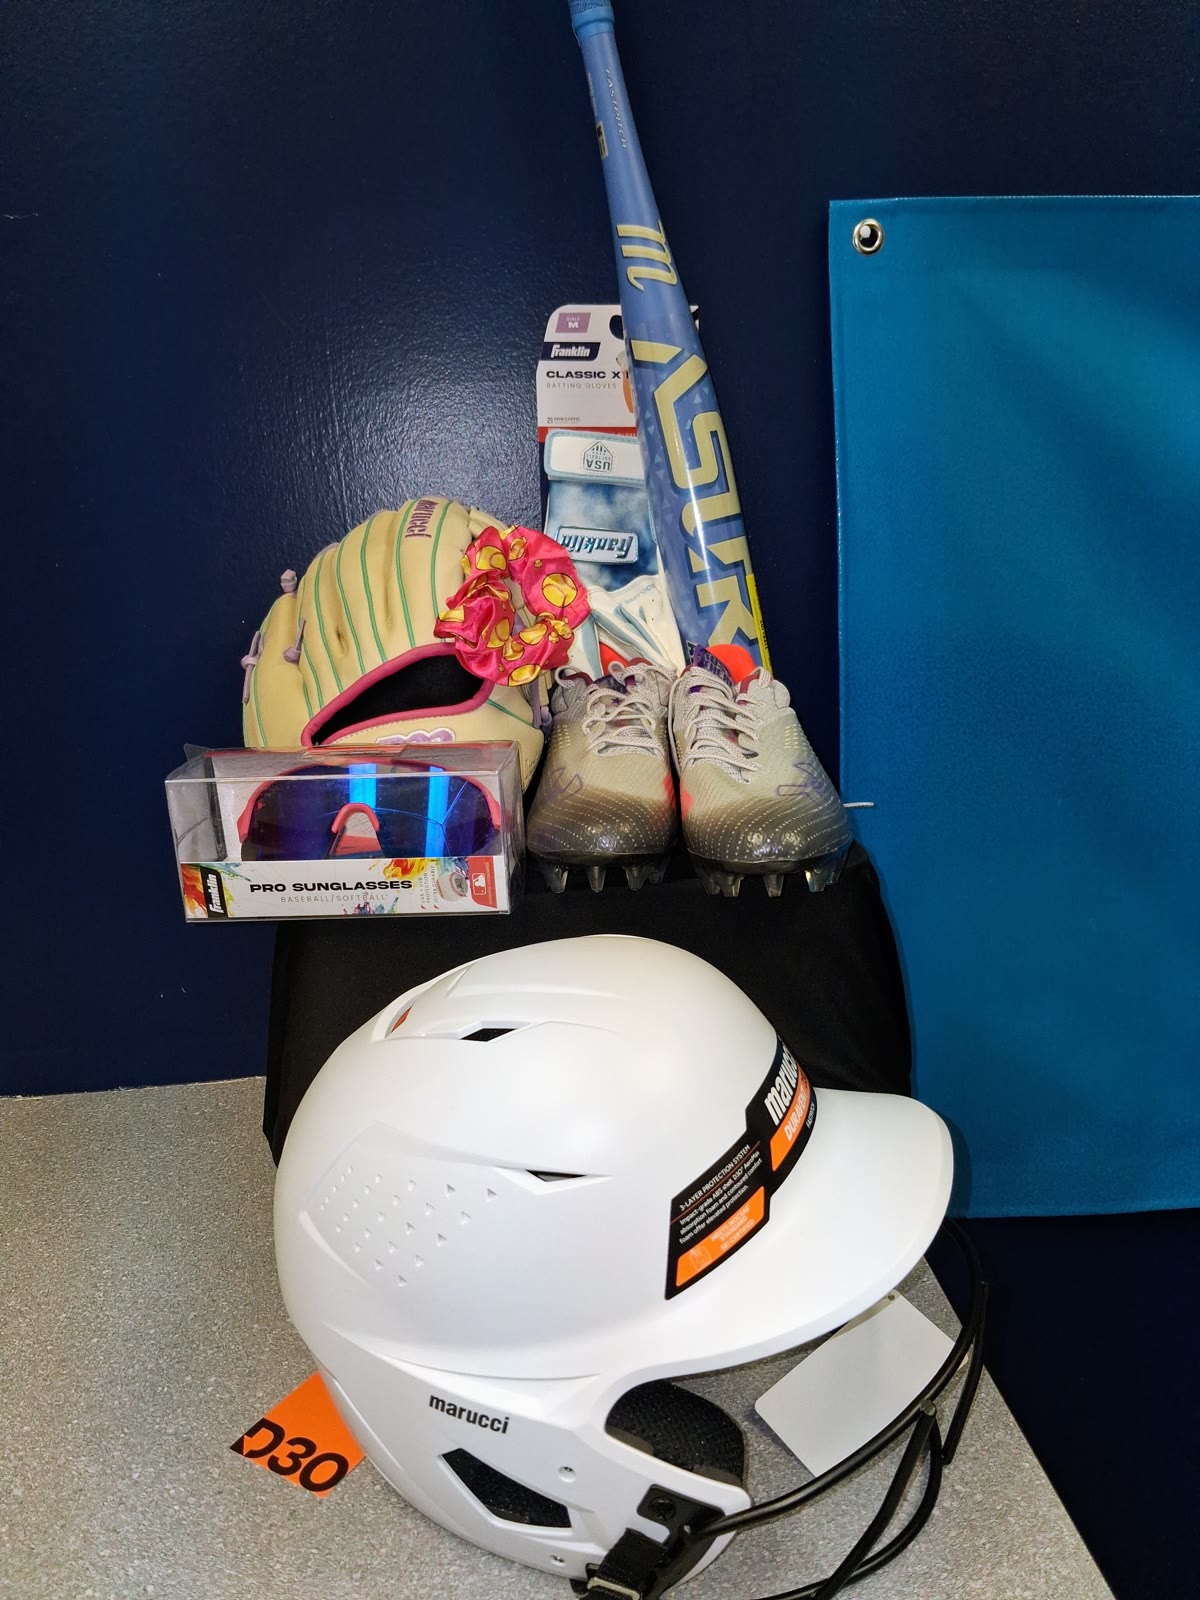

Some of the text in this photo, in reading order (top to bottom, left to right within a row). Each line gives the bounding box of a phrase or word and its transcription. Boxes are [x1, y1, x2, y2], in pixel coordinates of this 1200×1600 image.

[605, 69, 627, 149] FASTPITCH
[546, 370, 606, 379] CLASSIC
[612, 371, 621, 379] X
[586, 458, 610, 471] USA
[250, 880, 413, 893] PRO SUNGLASSES
[679, 1144, 751, 1212] 3-LAYER PROTECTION SYSTEM
[680, 1157, 763, 1236] absorption foam and contoured comfort
[679, 1197, 713, 1226] Impact-grade
[712, 1188, 723, 1200] ABS
[679, 1232, 694, 1244] foam
[693, 1222, 706, 1234] offer
[706, 1204, 726, 1224] elevated
[428, 1394, 510, 1434] marucci
